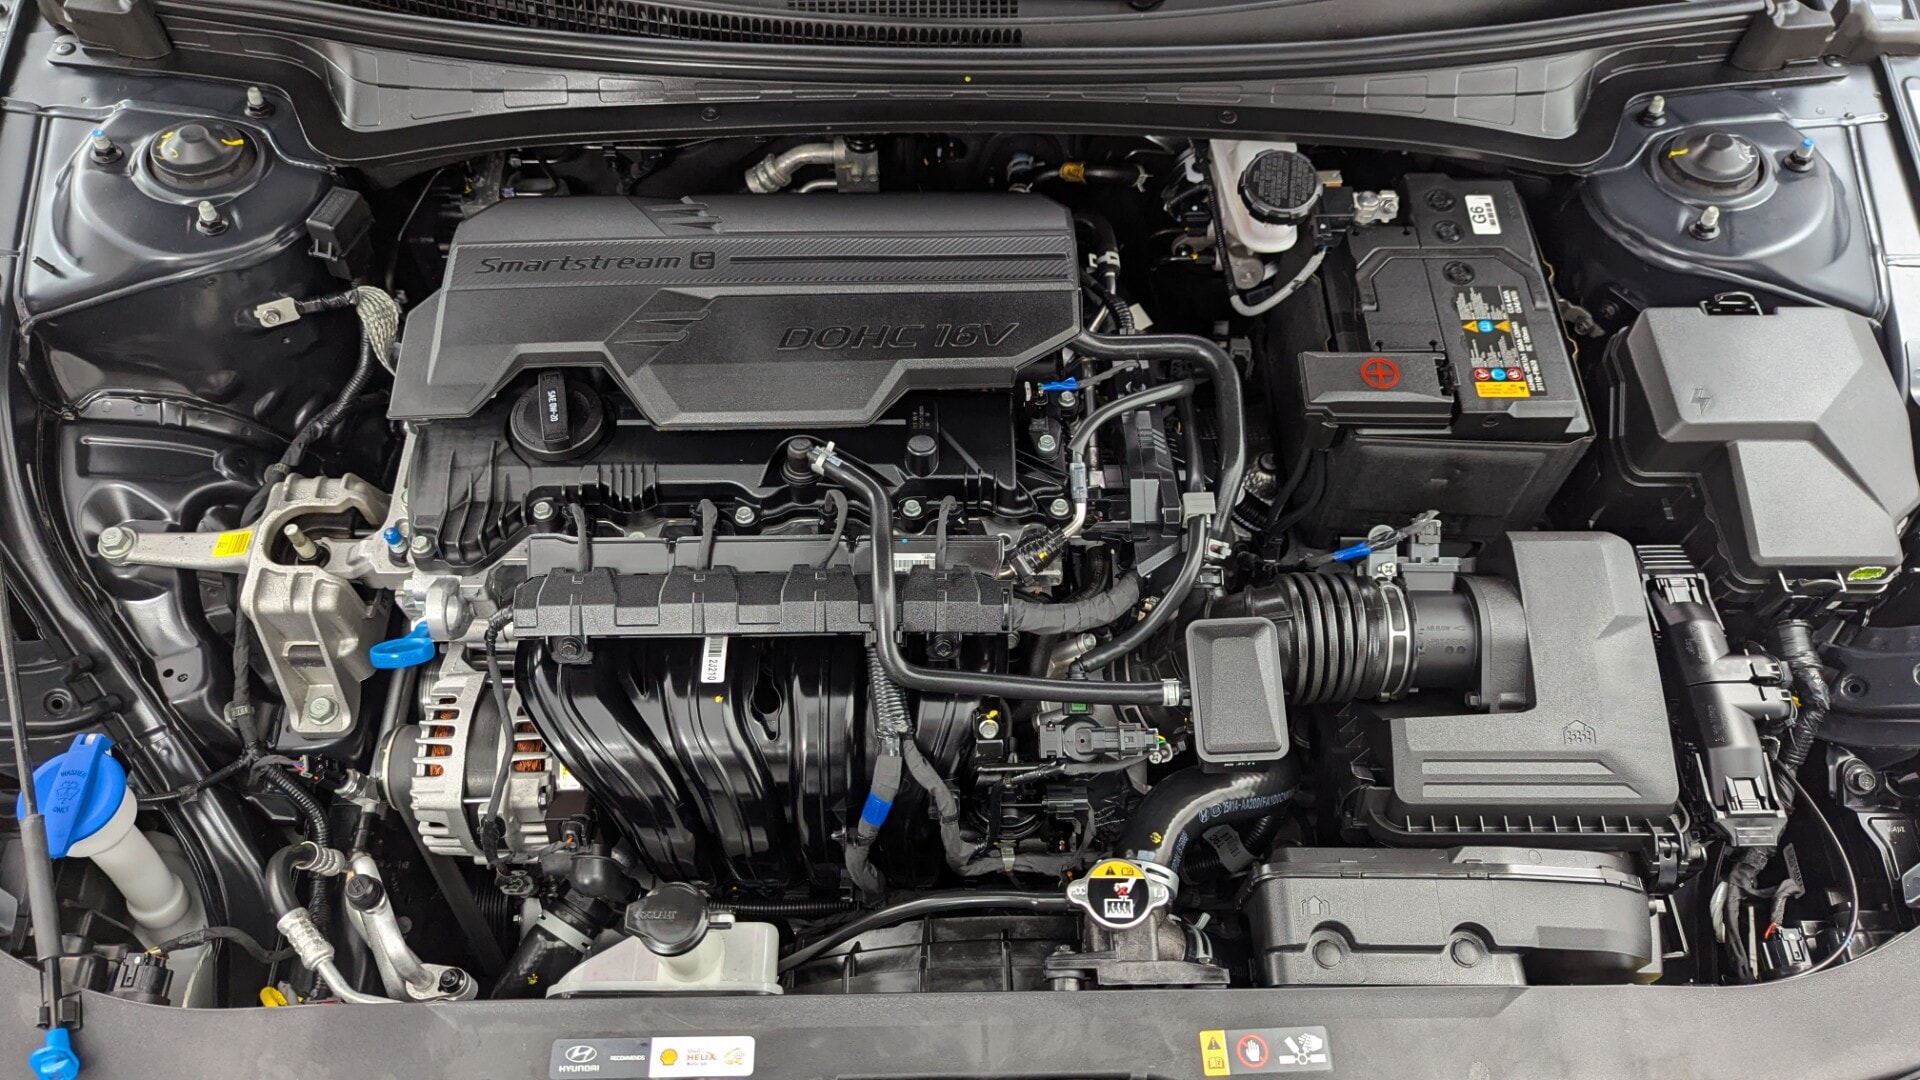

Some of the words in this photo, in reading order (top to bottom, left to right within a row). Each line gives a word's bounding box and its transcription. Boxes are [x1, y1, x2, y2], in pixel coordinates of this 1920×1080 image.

[1470, 206, 1487, 224] G6
[475, 255, 683, 274] Smartstream
[690, 252, 716, 270] G
[777, 325, 924, 349] DOHC
[934, 323, 1019, 347] 16V
[547, 390, 557, 403] SAE
[549, 403, 559, 422] 0W-20
[686, 1051, 718, 1061] HELIX
[558, 1064, 600, 1073] HYUNDAI
